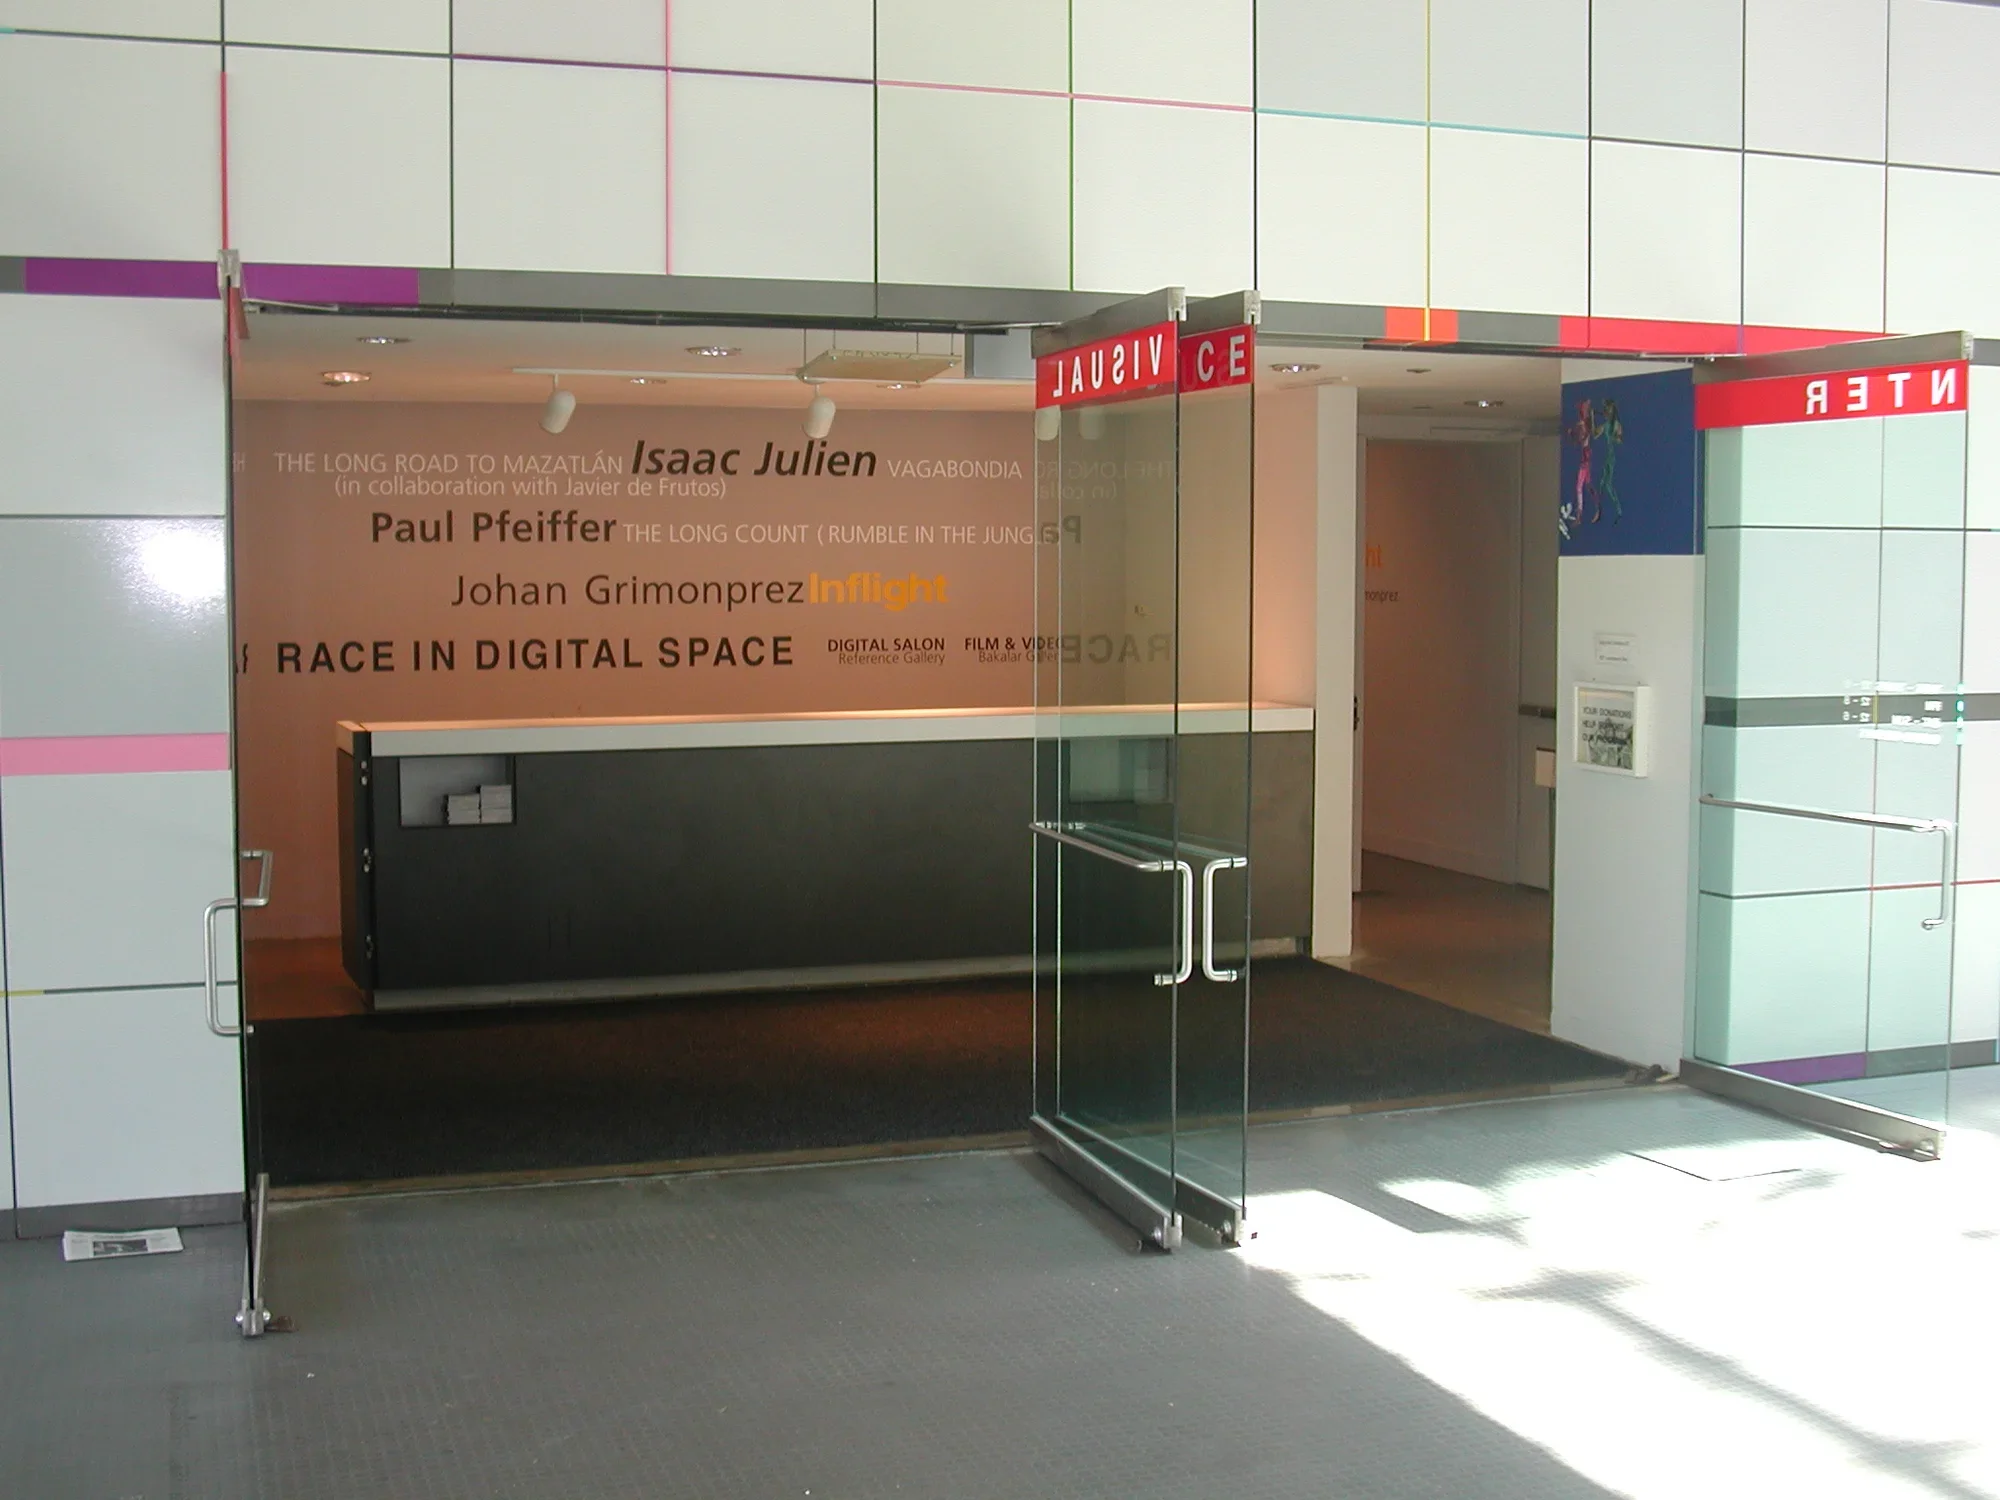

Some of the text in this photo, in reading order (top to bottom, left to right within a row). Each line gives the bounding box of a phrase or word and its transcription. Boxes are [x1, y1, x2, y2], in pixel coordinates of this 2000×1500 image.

[275, 449, 623, 475] THE LONG ROAD TO MAZATLÁN
[631, 440, 877, 477] Isaac Julien
[887, 459, 1023, 479] VAGABONDIA
[335, 475, 727, 499] (in collaboration with Javier de Frutos)
[372, 510, 617, 543] Paul Pfeiffer
[623, 524, 662, 544] THE
[669, 524, 728, 544] LONG
[735, 524, 809, 544] COUNT
[915, 525, 934, 544] IN
[940, 525, 976, 544] THE
[452, 574, 804, 612] Johan Grimonprez
[809, 572, 949, 611] Inflight
[277, 641, 394, 673] RACE
[413, 640, 455, 671] IN
[476, 638, 642, 670] DIGITAL
[659, 635, 793, 668] SPACE
[828, 637, 945, 652] DIGITAL SALON
[964, 637, 1000, 650] FILM
[1004, 637, 1016, 650] &
[838, 652, 945, 667] Reference Gallery
[978, 650, 1022, 663] Bakalar
